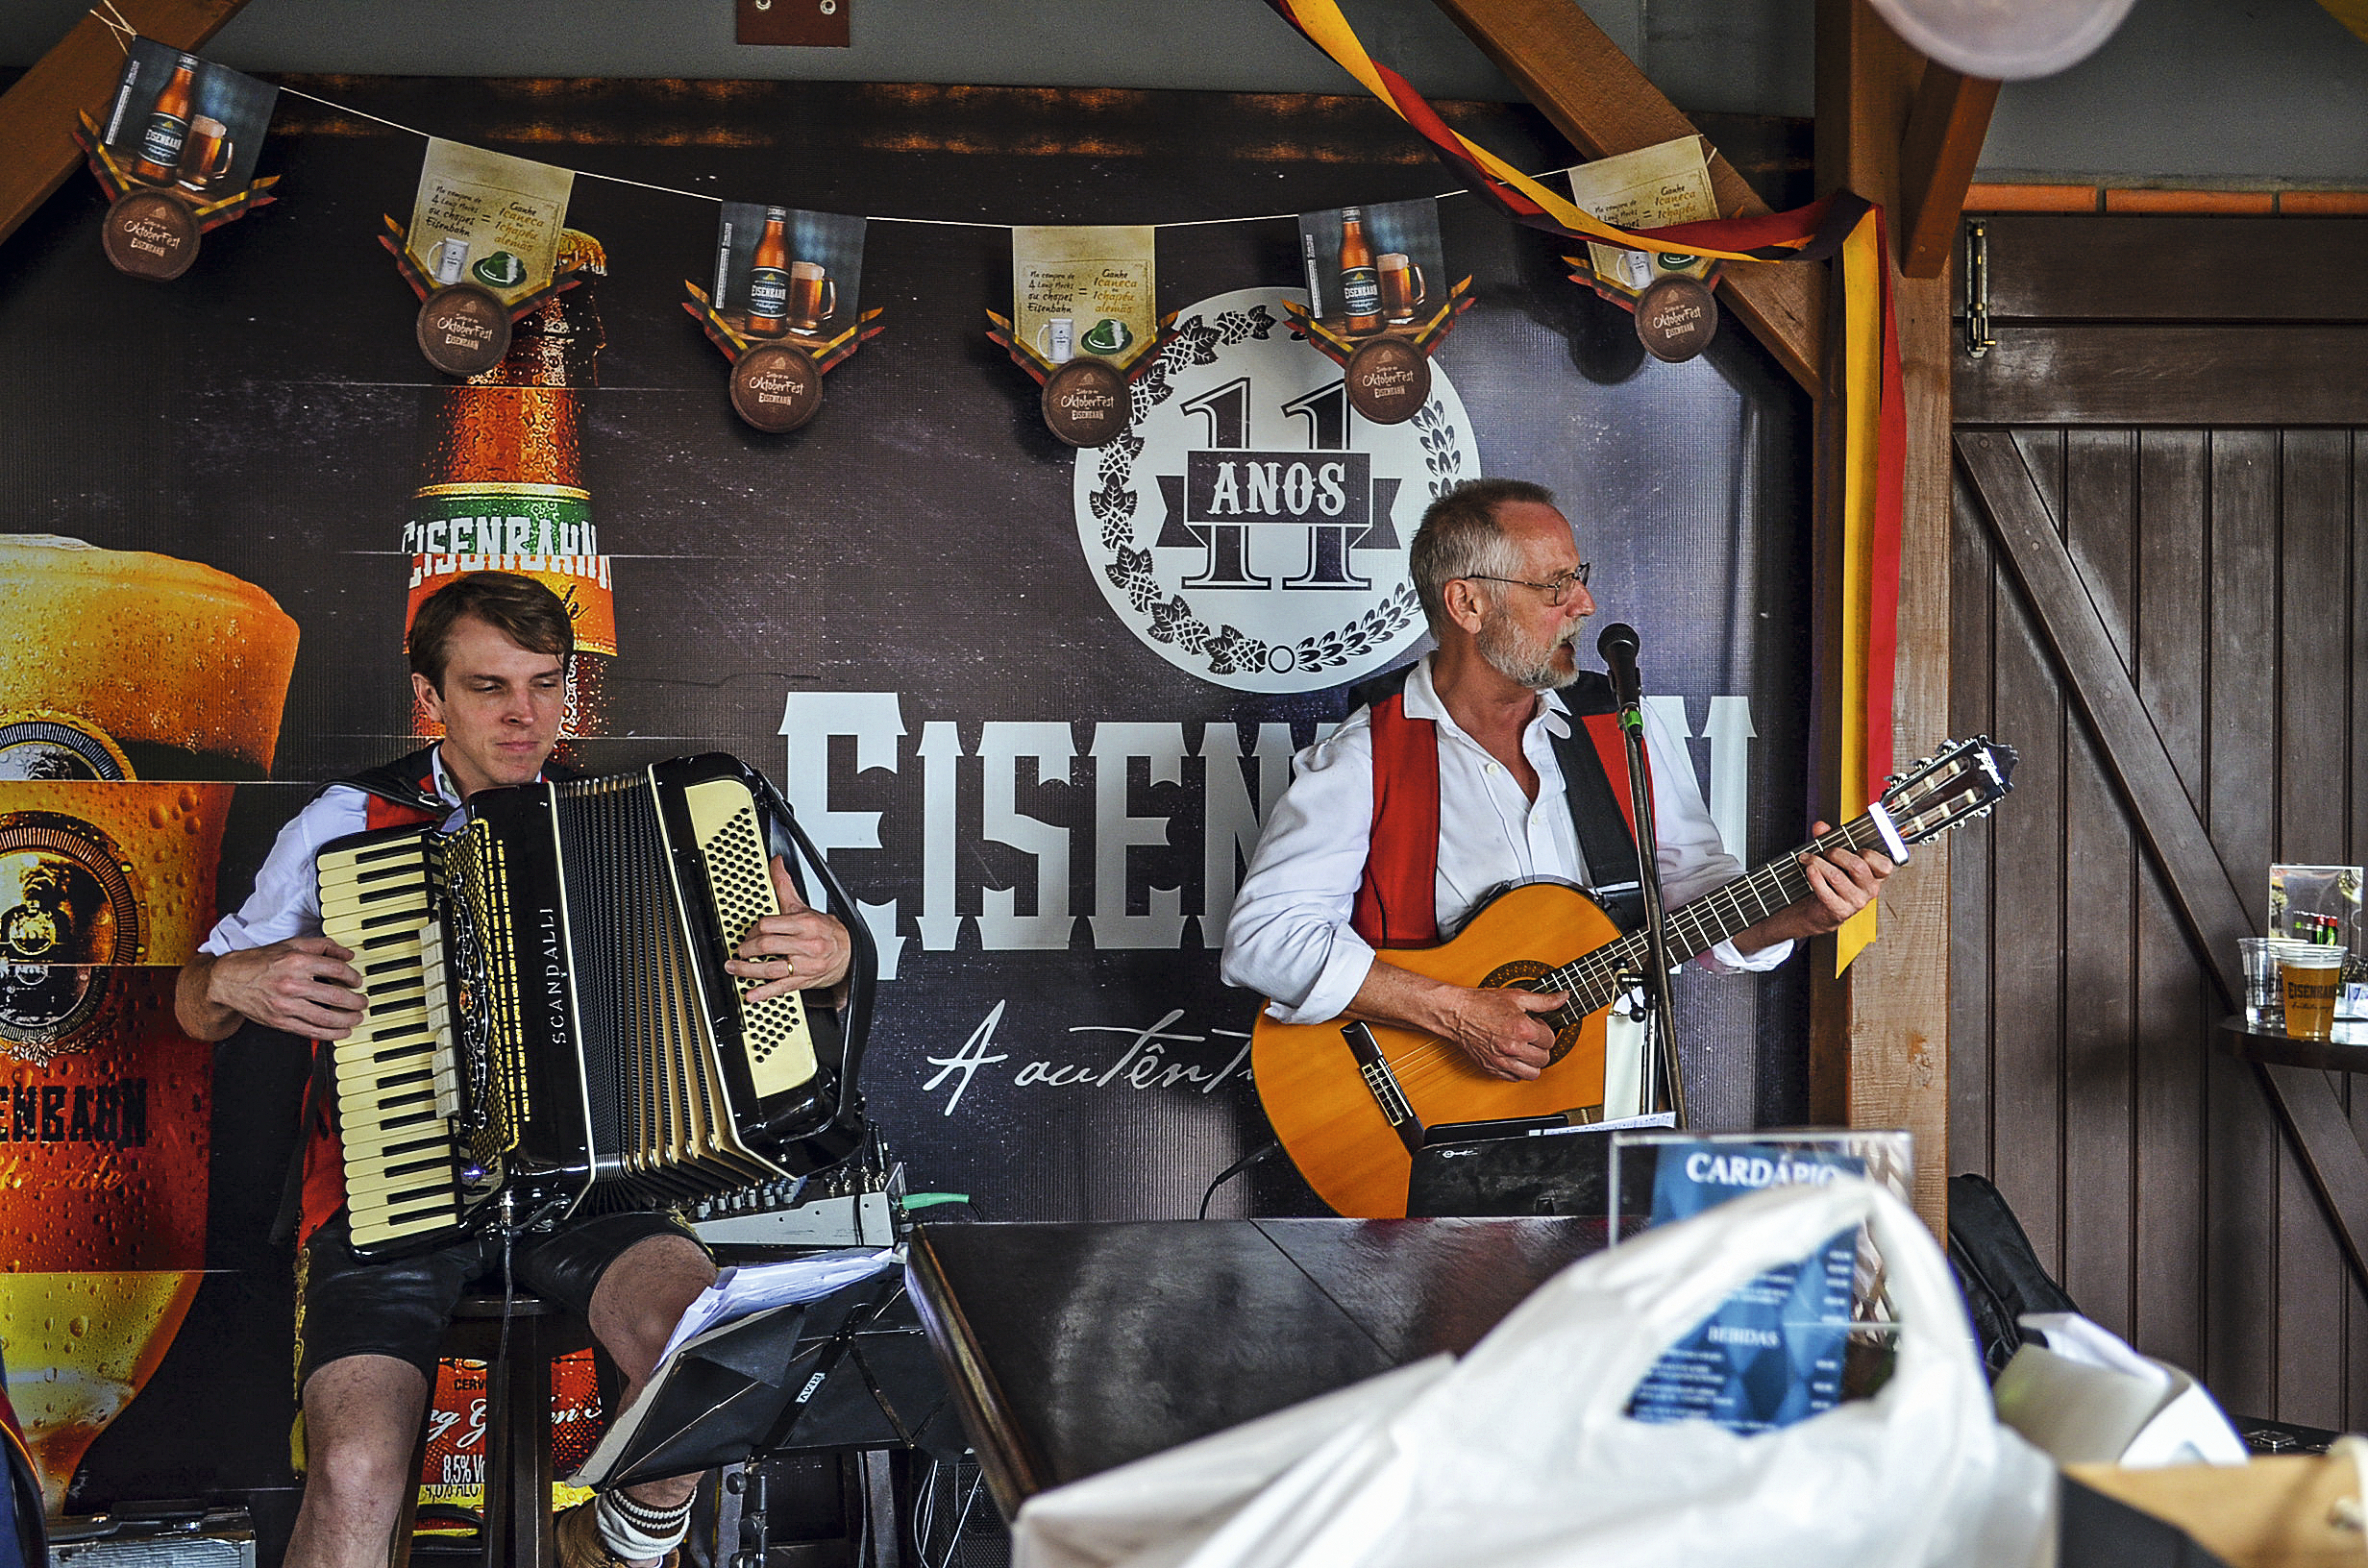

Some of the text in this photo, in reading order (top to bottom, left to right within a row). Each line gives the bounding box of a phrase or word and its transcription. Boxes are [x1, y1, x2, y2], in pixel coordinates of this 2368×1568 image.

[426, 216, 470, 237] Eisenbahn
[1101, 268, 1128, 279] Ganhe
[1027, 302, 1073, 313] Eisenbahn
[1043, 288, 1073, 305] chopes
[1207, 460, 1345, 516] ANOS
[539, 908, 567, 1044] SCANDALLI
[923, 998, 1008, 1116] A
[800, 1374, 822, 1401] RMV
